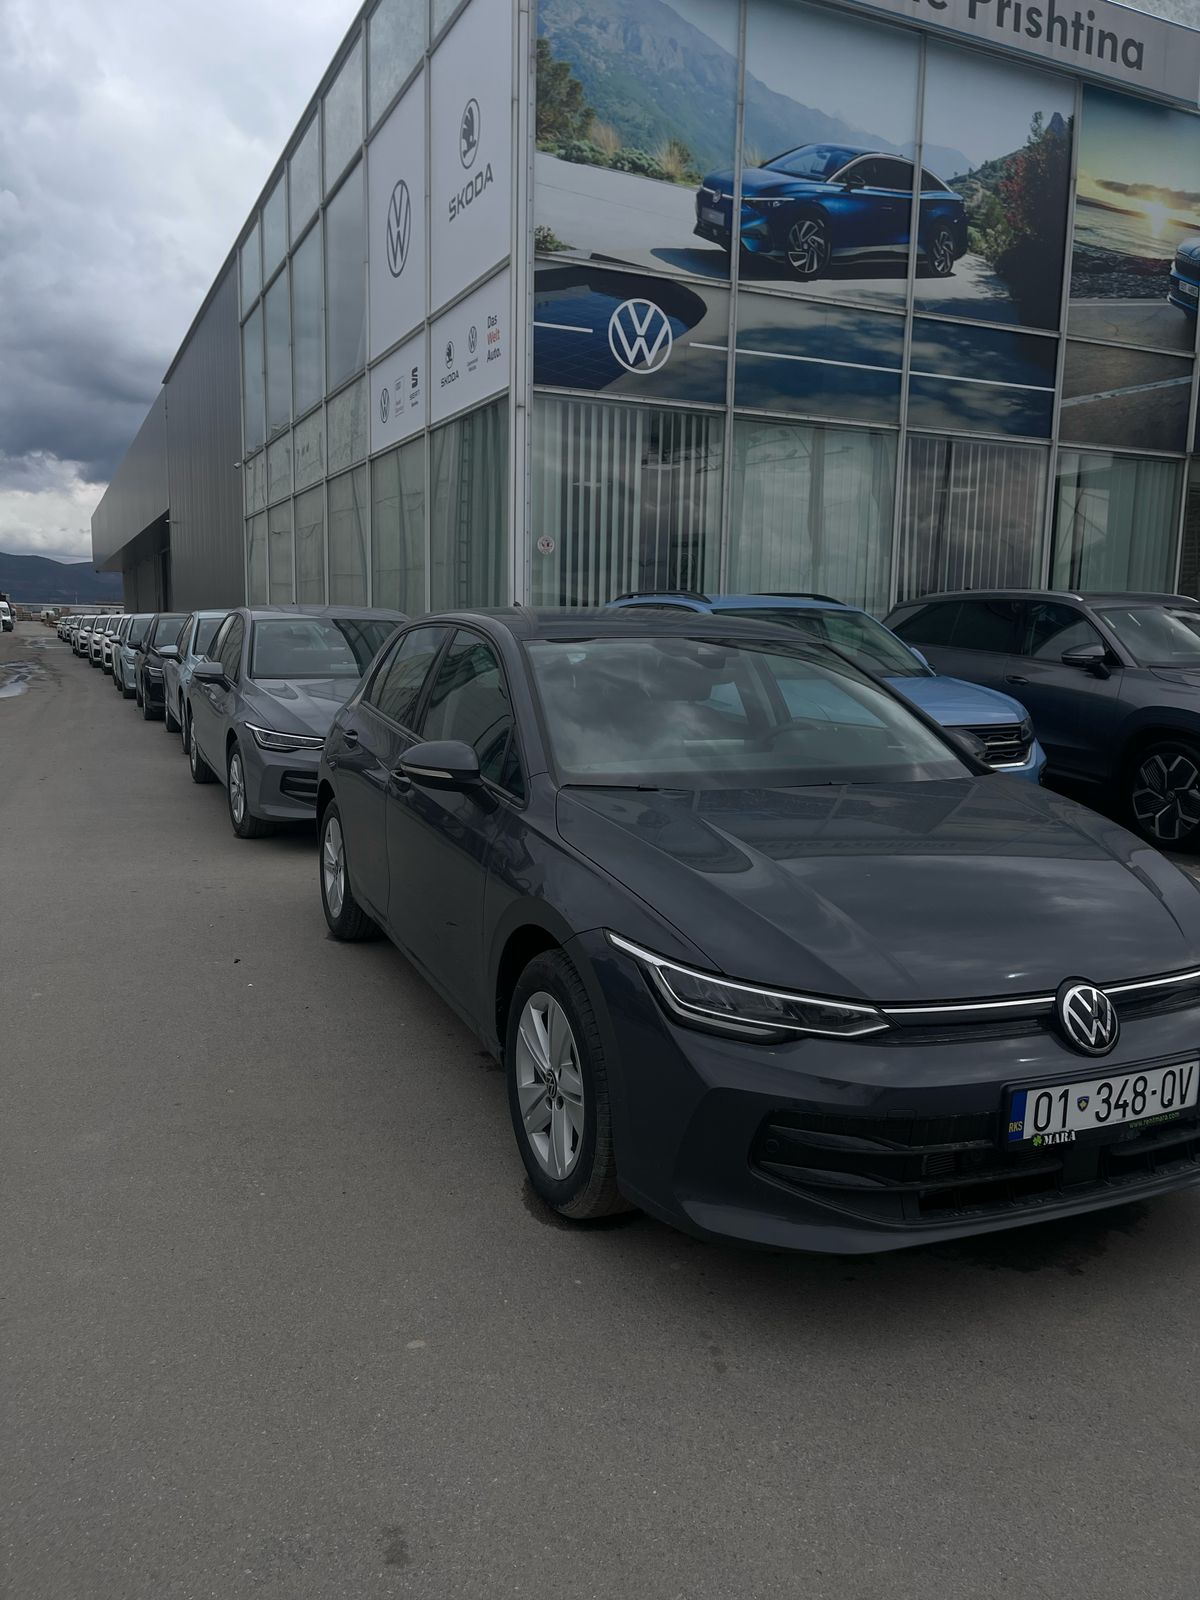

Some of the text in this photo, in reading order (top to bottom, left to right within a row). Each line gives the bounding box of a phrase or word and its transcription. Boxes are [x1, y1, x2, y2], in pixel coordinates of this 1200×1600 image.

[610, 300, 671, 370] VW
[1033, 1066, 1194, 1131] 01 348-QV
[1008, 1121, 1023, 1133] RKS
[1043, 1131, 1076, 1145] MARA
